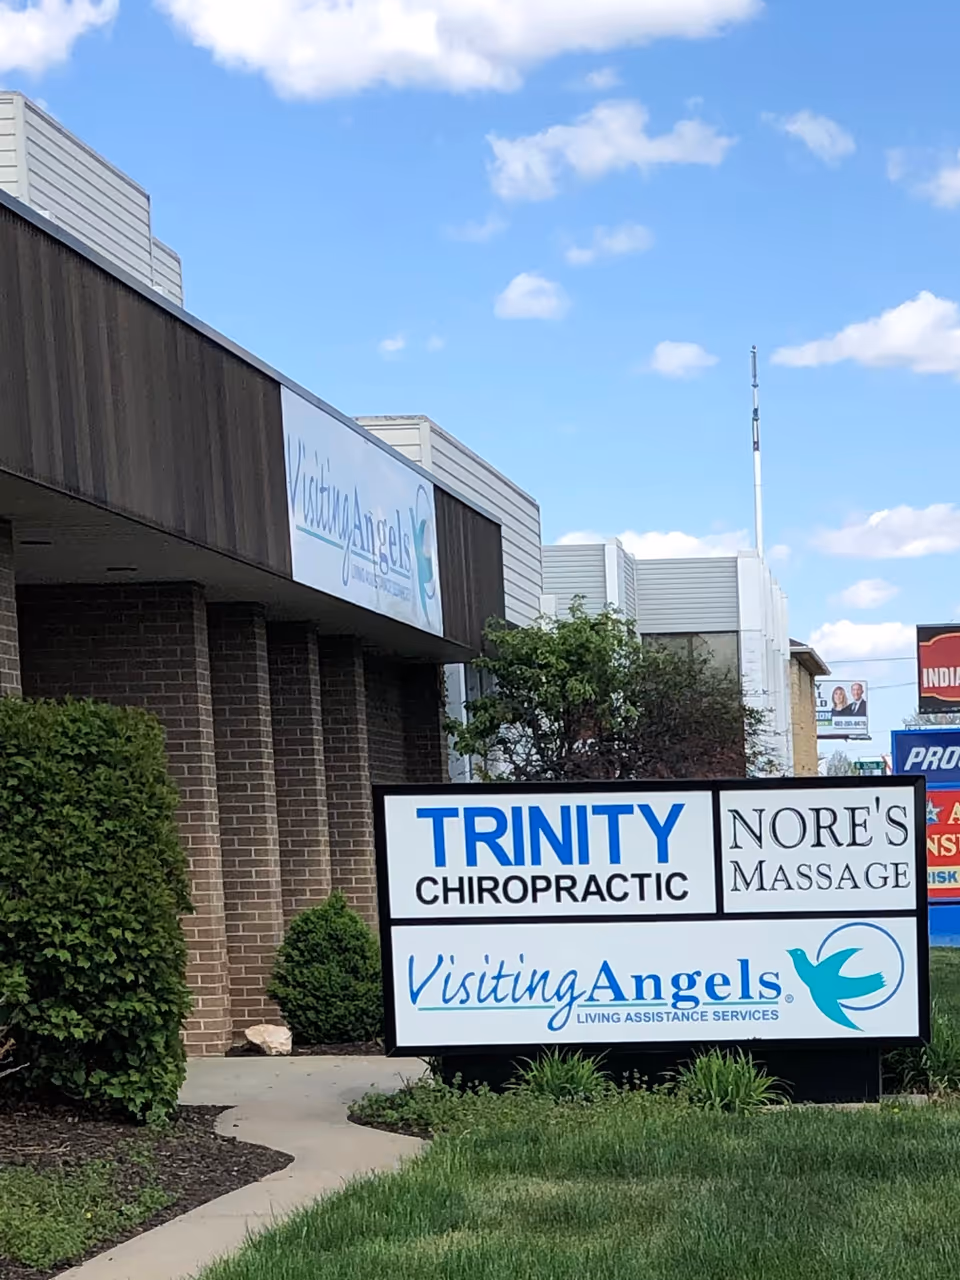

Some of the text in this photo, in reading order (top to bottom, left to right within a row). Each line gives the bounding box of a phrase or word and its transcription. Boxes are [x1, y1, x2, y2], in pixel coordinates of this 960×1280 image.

[416, 803, 686, 867] TRINITY
[727, 796, 909, 849] NORE'S
[416, 872, 689, 905] CHIROPRACTIC
[729, 859, 911, 892] MASSAGE
[576, 1009, 780, 1024] LIVING ASSISTANCE SERVICES
